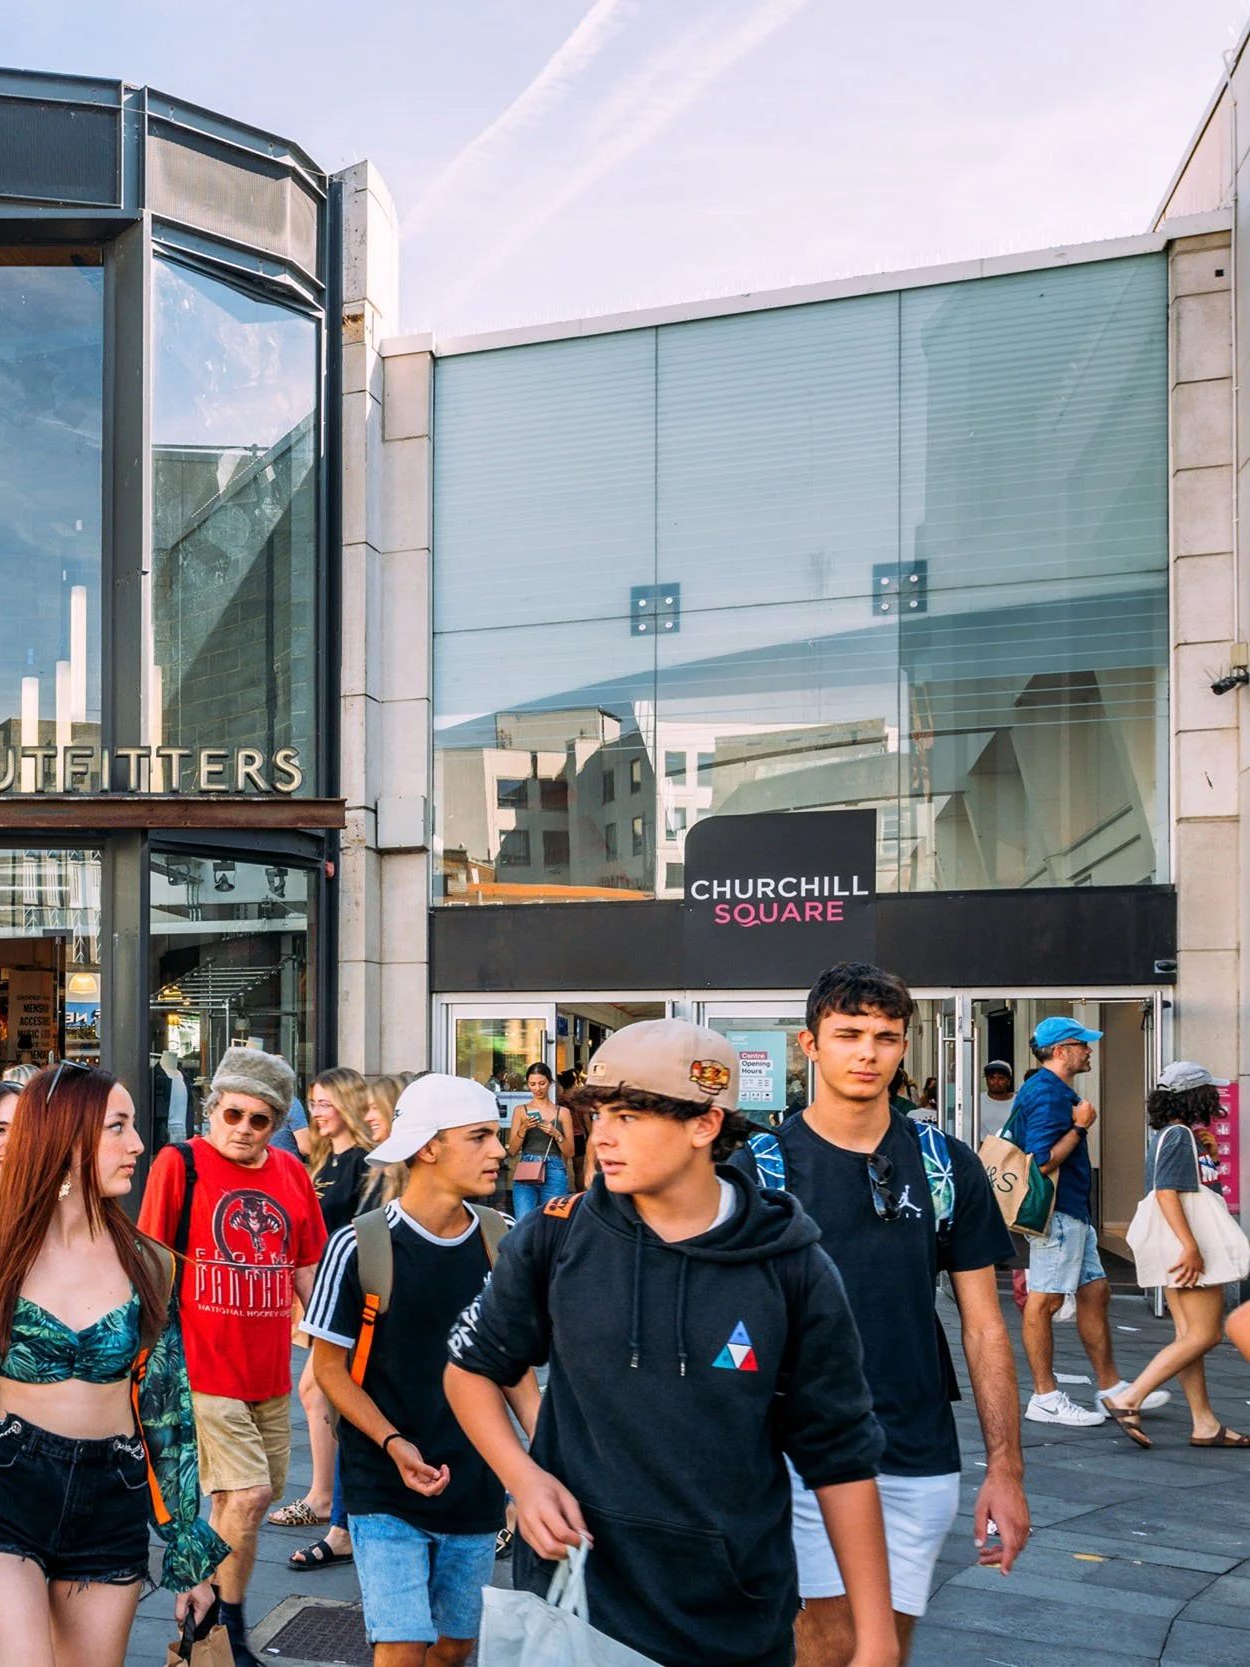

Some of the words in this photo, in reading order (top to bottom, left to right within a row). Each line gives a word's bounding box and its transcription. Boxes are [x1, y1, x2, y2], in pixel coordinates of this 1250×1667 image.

[690, 875, 869, 900] CHURCHILL
[714, 901, 845, 928] SQUARE
[198, 1304, 246, 1317] NATIONAL
